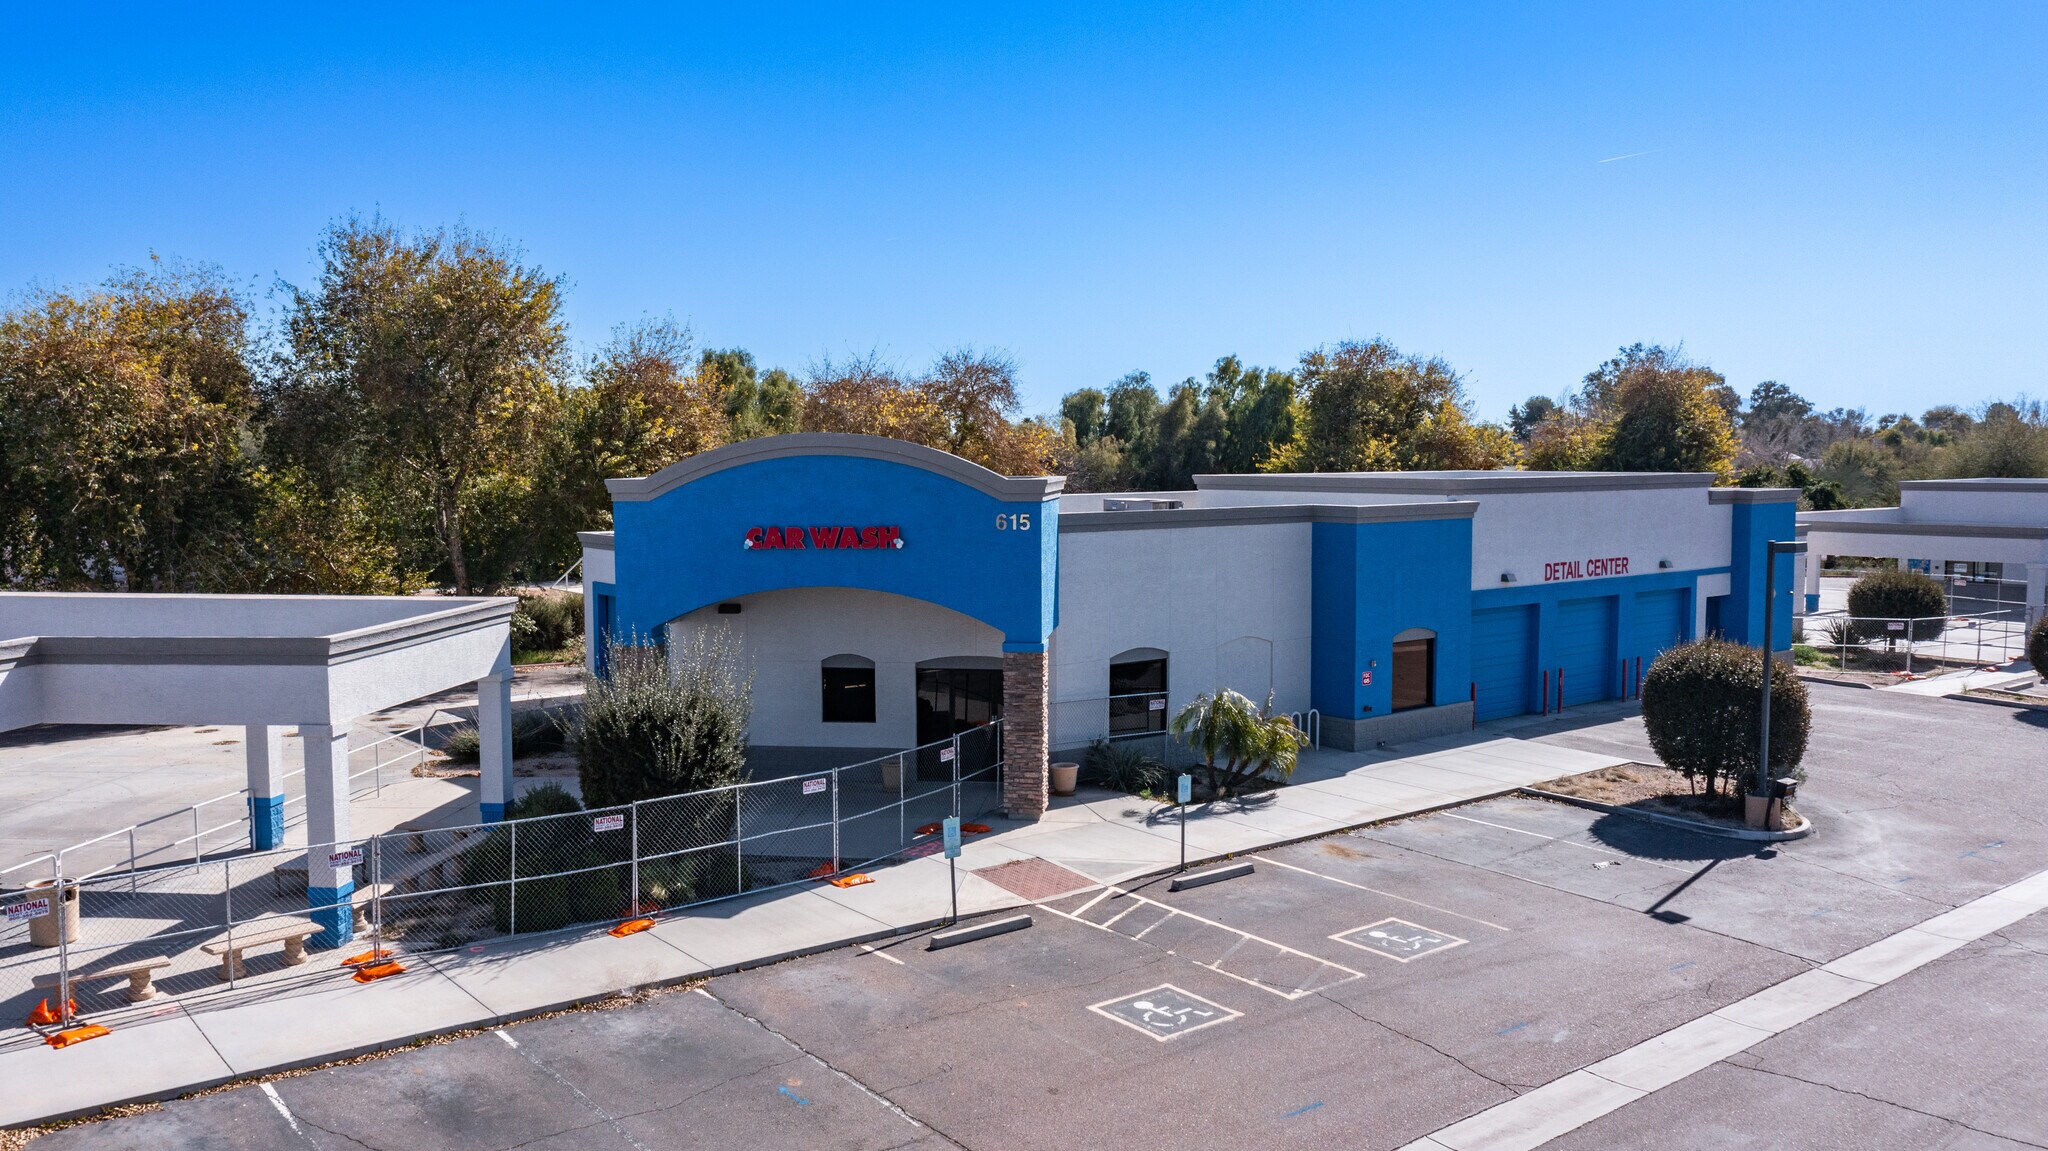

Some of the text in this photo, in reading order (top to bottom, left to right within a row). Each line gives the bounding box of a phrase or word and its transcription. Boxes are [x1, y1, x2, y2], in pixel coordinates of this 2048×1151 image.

[995, 513, 1031, 531] 615
[745, 526, 900, 550] CAR WASH
[1544, 557, 1629, 581] DETAIL CENTER
[595, 815, 623, 825] NATIONAL
[328, 849, 362, 862] NATIONAL
[7, 899, 48, 915] NATIONAL
